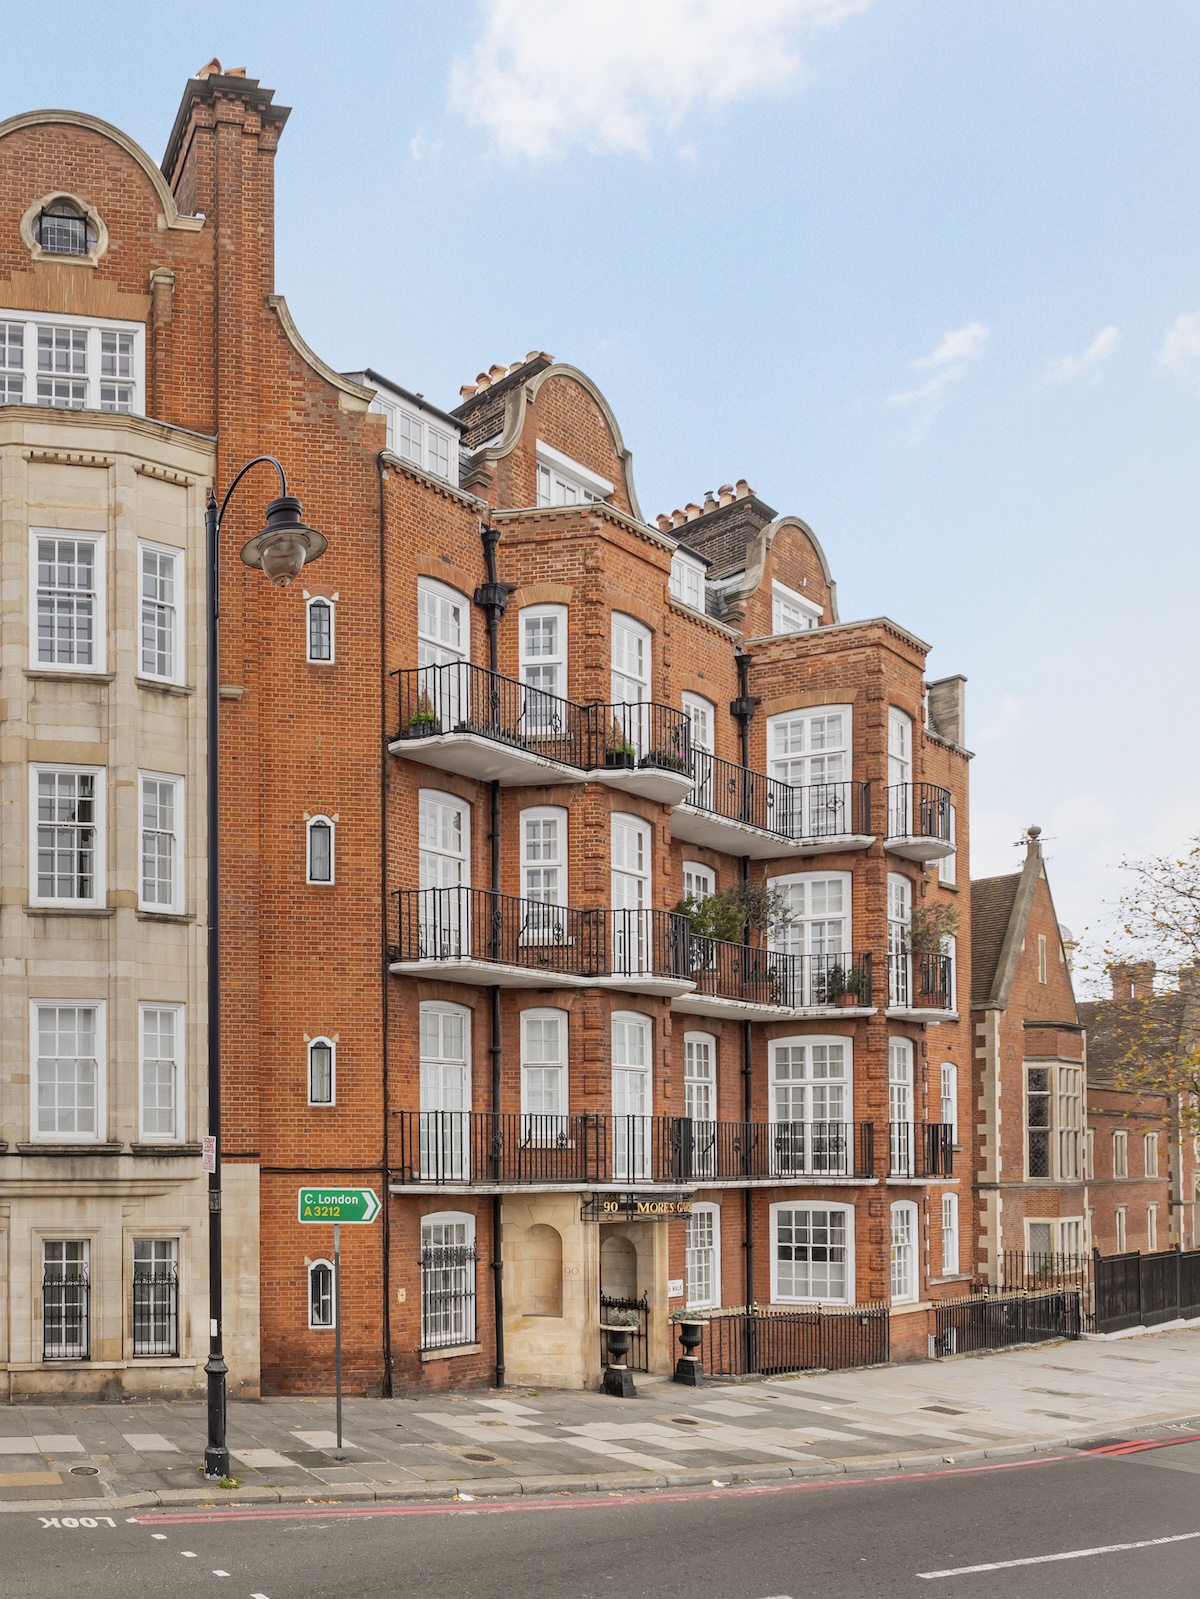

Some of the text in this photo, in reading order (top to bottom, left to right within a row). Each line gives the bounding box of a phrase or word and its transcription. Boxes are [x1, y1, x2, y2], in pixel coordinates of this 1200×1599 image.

[304, 1194, 358, 1204] C. London
[603, 1201, 619, 1213] 90
[564, 1266, 579, 1277] 90
[38, 1516, 117, 1529] LOOK
